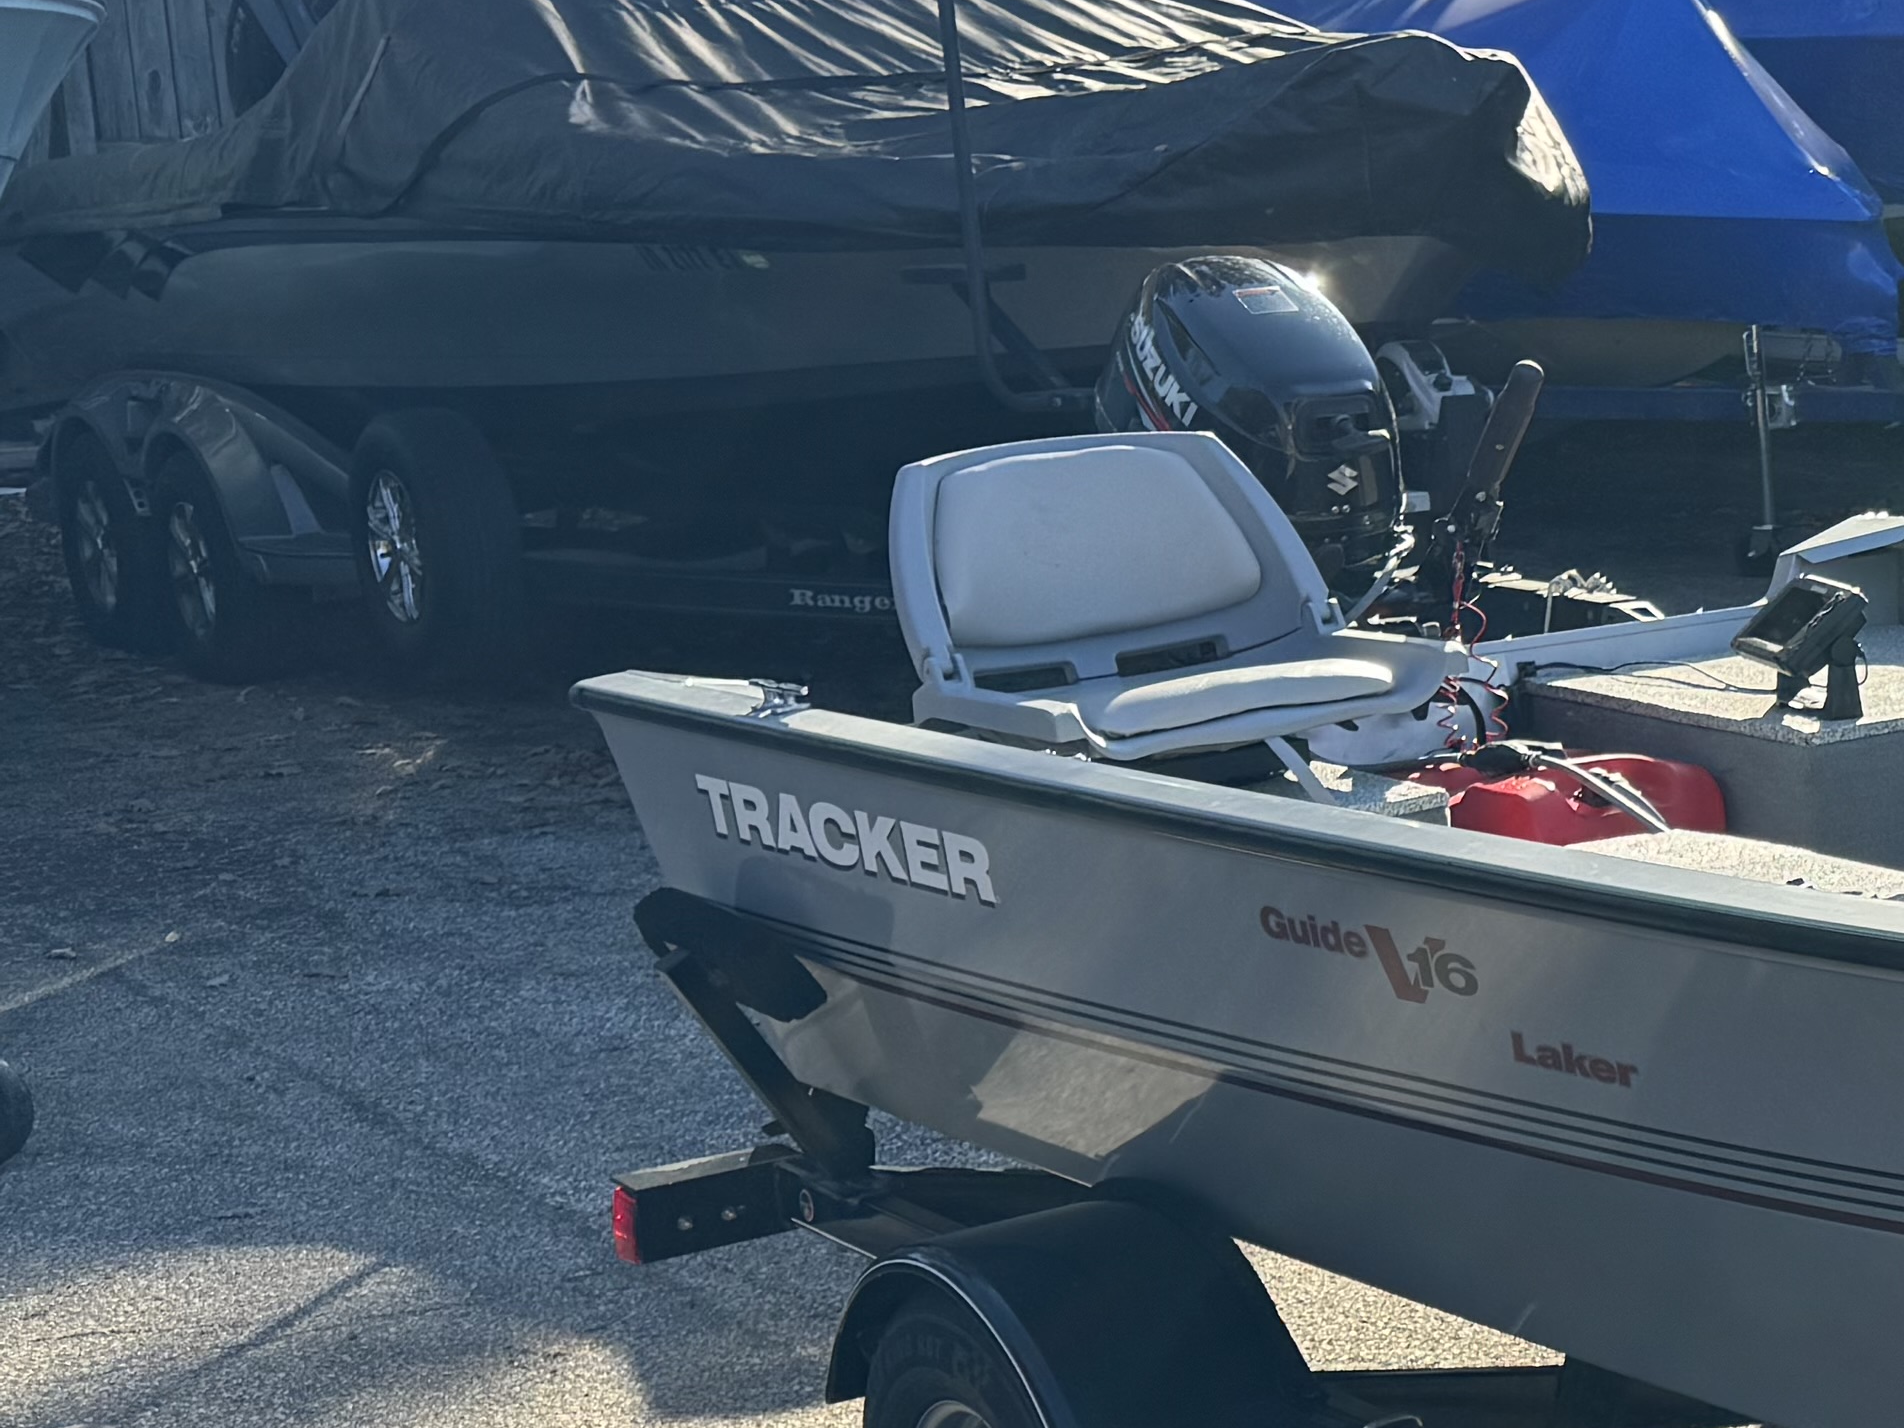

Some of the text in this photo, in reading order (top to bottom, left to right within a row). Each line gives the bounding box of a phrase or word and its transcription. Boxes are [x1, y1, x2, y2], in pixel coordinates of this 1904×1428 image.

[1130, 312, 1199, 427] SUZUKI
[788, 588, 897, 613] Range
[695, 772, 999, 908] TRACKER
[1260, 905, 1479, 1004] Guide V16
[1510, 1030, 1639, 1088] Laker
